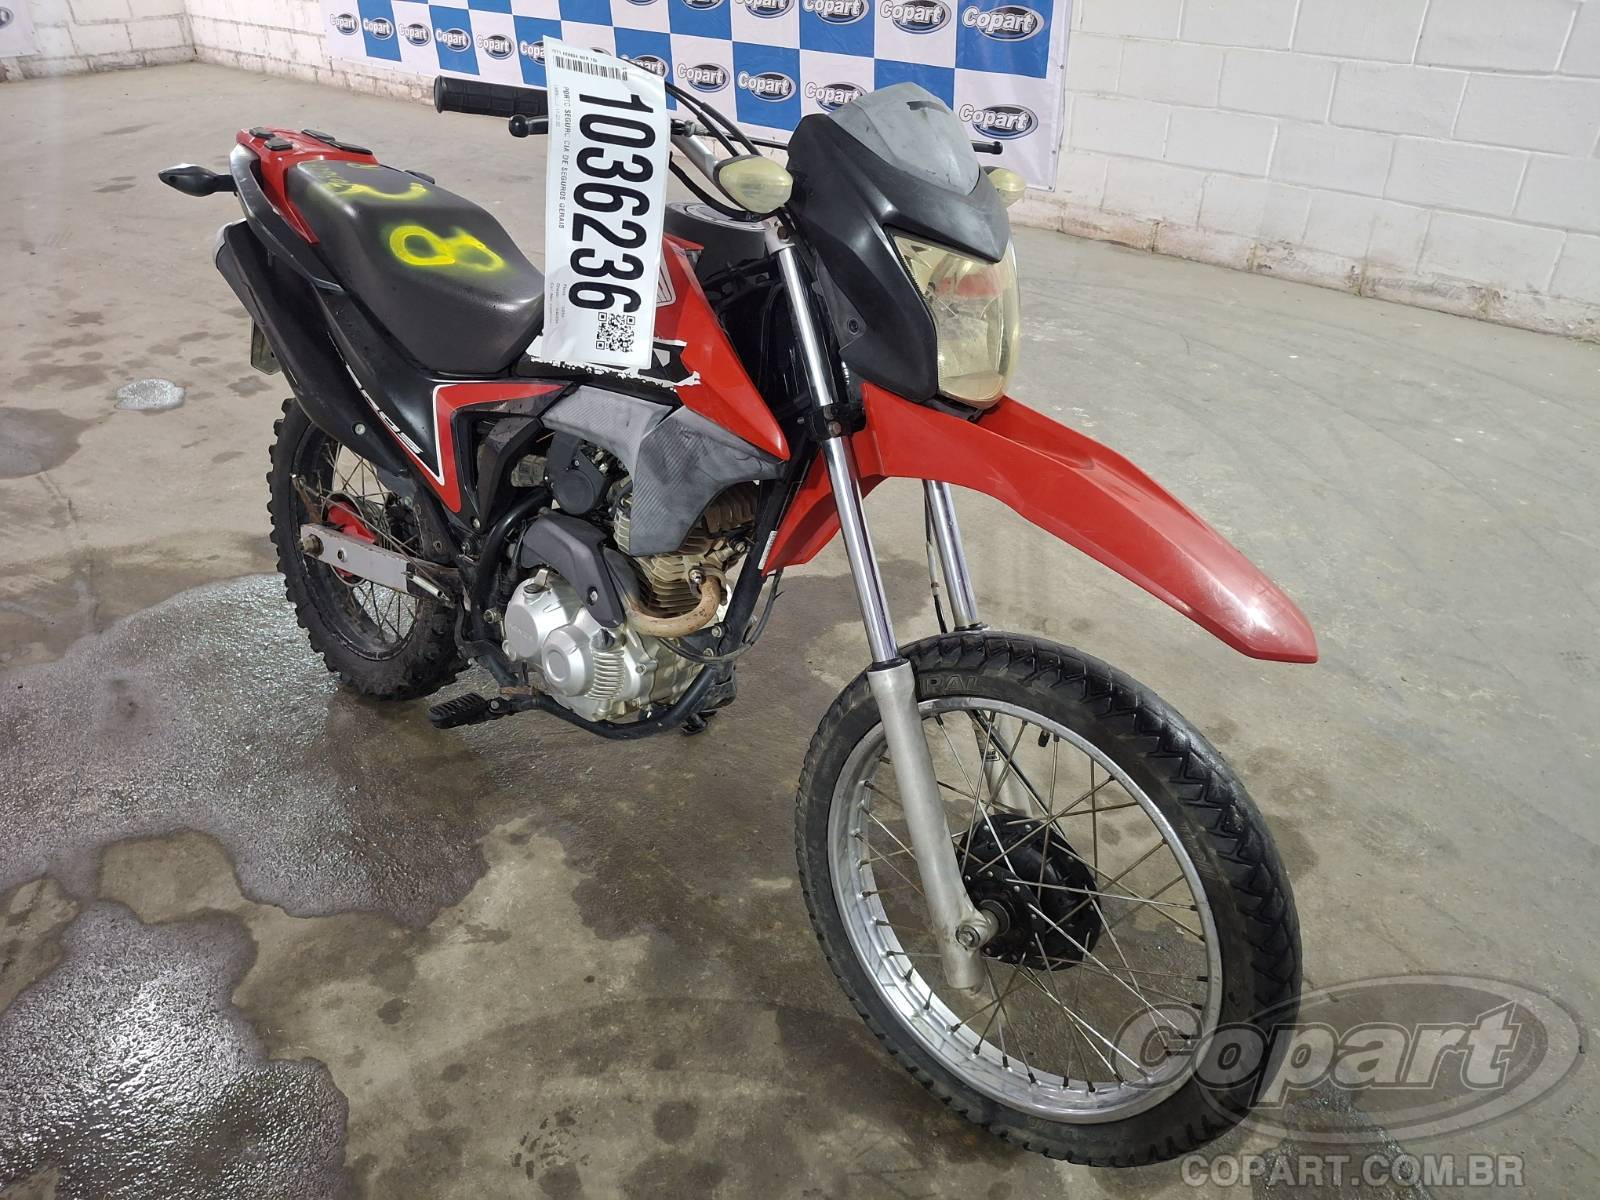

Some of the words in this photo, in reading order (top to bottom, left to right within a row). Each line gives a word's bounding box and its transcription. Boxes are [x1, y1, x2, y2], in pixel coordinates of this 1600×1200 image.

[330, 14, 355, 28] Copart
[880, 0, 943, 25] Copart
[962, 6, 1035, 34] Copart
[363, 18, 390, 34] Copart
[400, 24, 427, 39] Copart
[435, 28, 467, 46] Copart
[476, 33, 510, 53] Copart
[677, 63, 724, 86] Copart
[737, 71, 790, 96] Copart
[805, 81, 860, 106] Copart
[959, 104, 1030, 131] Copart
[559, 167, 568, 201] SEGUROS
[568, 93, 656, 313] 1036236
